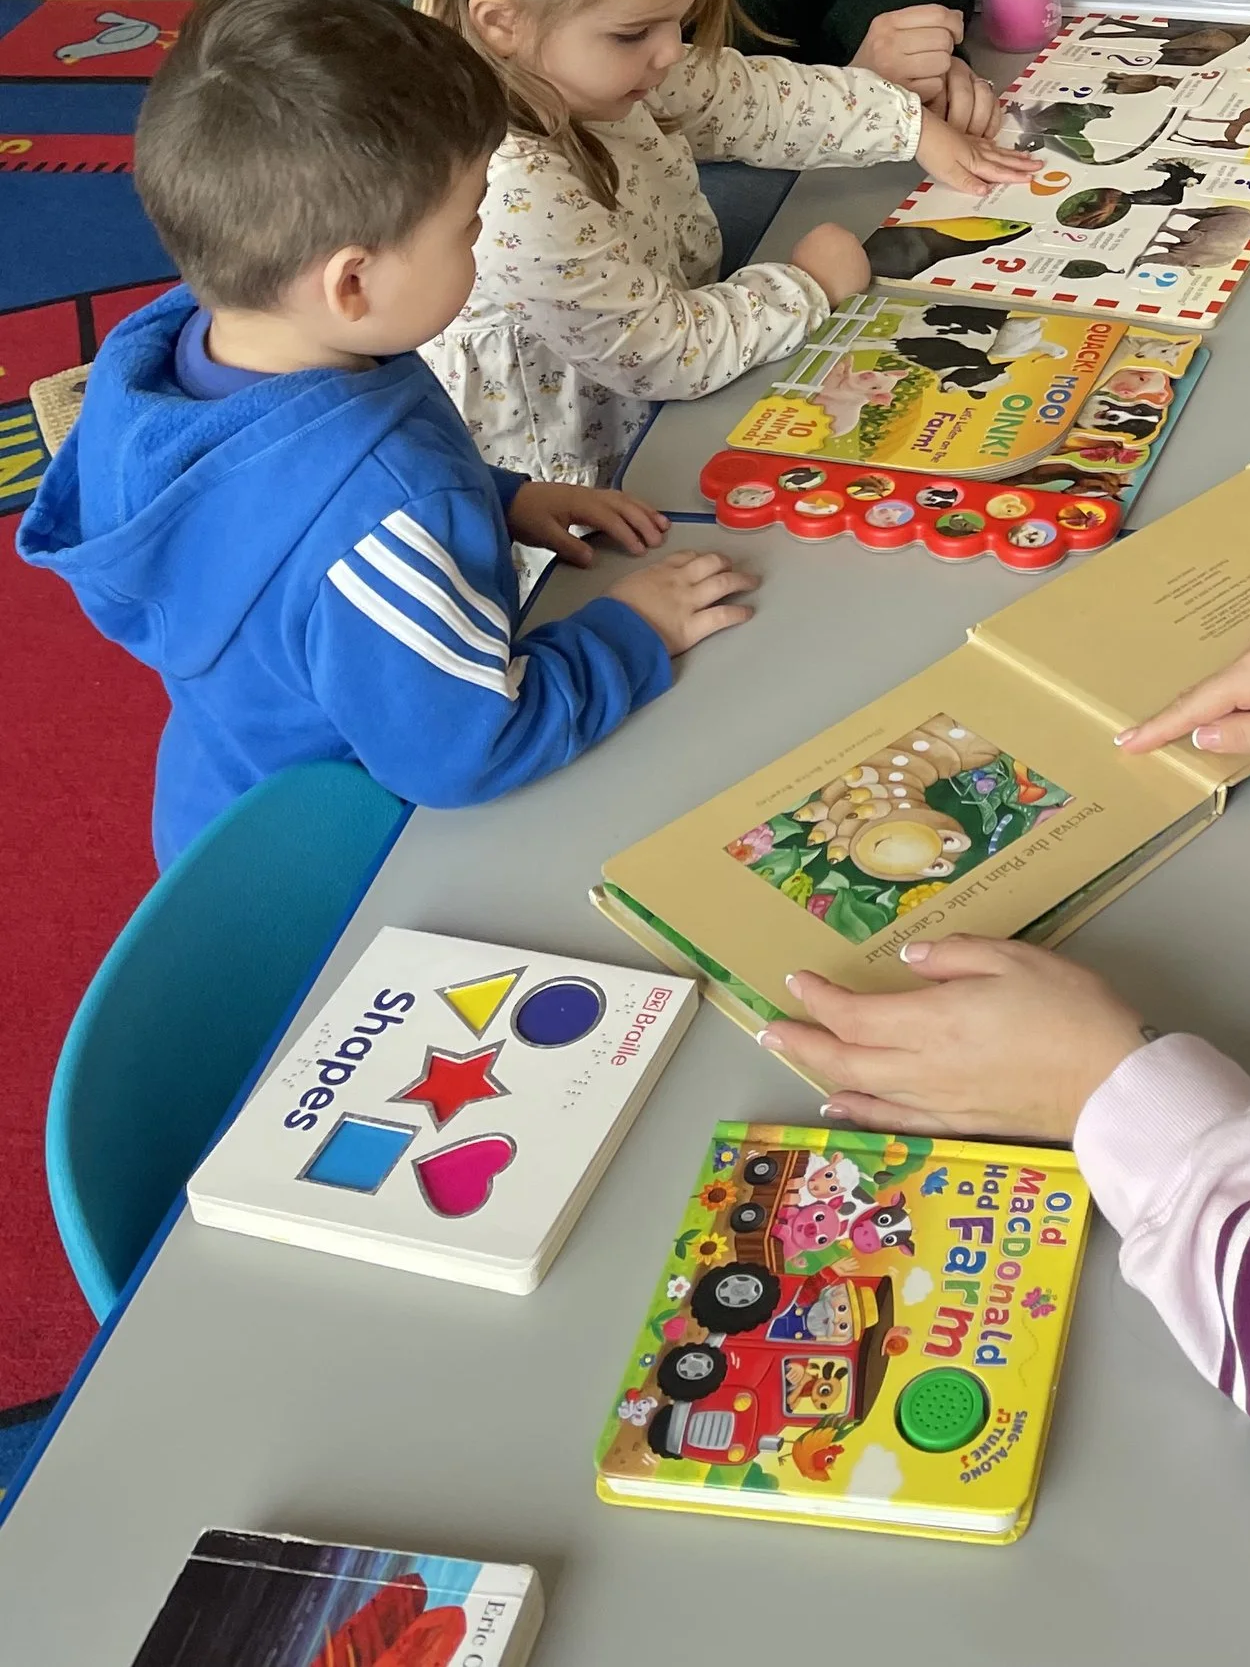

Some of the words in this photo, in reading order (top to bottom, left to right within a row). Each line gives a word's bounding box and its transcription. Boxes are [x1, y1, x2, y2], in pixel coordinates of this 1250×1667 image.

[1071, 323, 1112, 373] QUACK!
[1035, 375, 1079, 425] MOO!
[755, 406, 799, 446] ANIMAL
[787, 420, 817, 438] 10
[910, 411, 956, 453] Farm!
[978, 394, 1033, 457] OINK!
[1048, 801, 1105, 842] Percival
[984, 855, 1027, 882] Plain
[1024, 837, 1051, 857] the
[948, 880, 989, 911] Little
[865, 909, 945, 964] Caterpillar
[646, 989, 668, 1010] DK
[283, 988, 415, 1133] Shapes
[611, 1014, 657, 1065] Braille
[957, 1181, 975, 1196] a
[976, 1164, 1009, 1210] Had
[1040, 1191, 1072, 1246] Old
[923, 1217, 995, 1358] Farm
[975, 1167, 1047, 1366] MacDonald
[960, 1410, 1028, 1484] SING-ALONG
[970, 1428, 1006, 1462] TUNE
[471, 1601, 507, 1646] Eric
